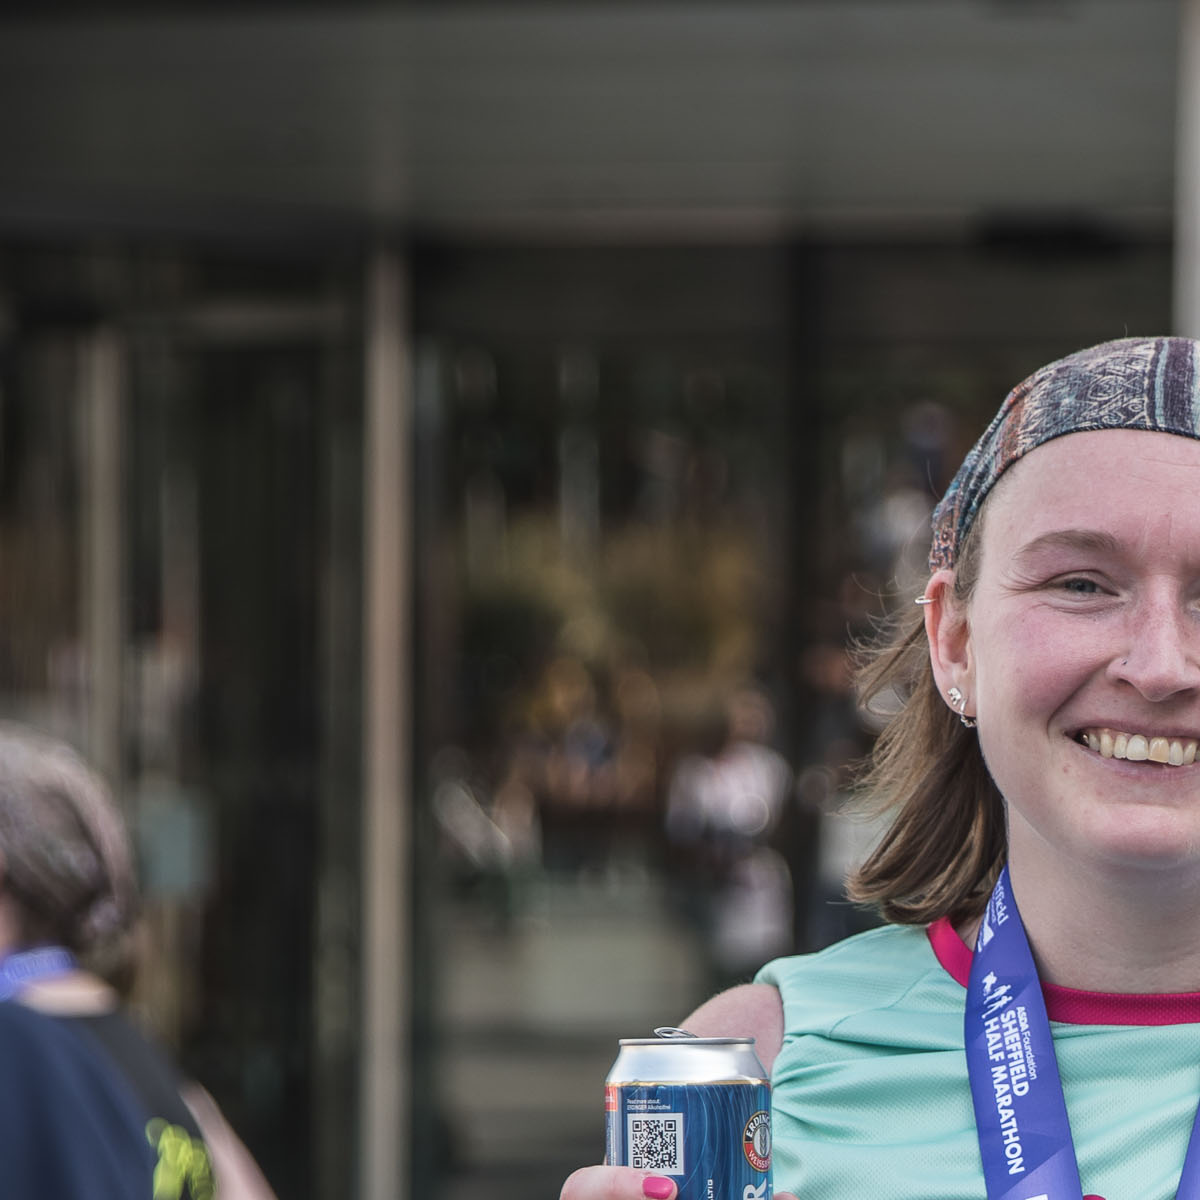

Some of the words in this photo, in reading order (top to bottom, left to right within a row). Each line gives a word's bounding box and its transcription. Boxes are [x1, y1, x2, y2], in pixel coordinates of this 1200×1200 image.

[984, 1017, 1005, 1062] HALF
[1016, 1006, 1029, 1032] ASDA
[1000, 1009, 1030, 1097] SHEFFIELD
[1021, 1032, 1037, 1081] Foundation
[991, 1065, 1026, 1175] MARATHON
